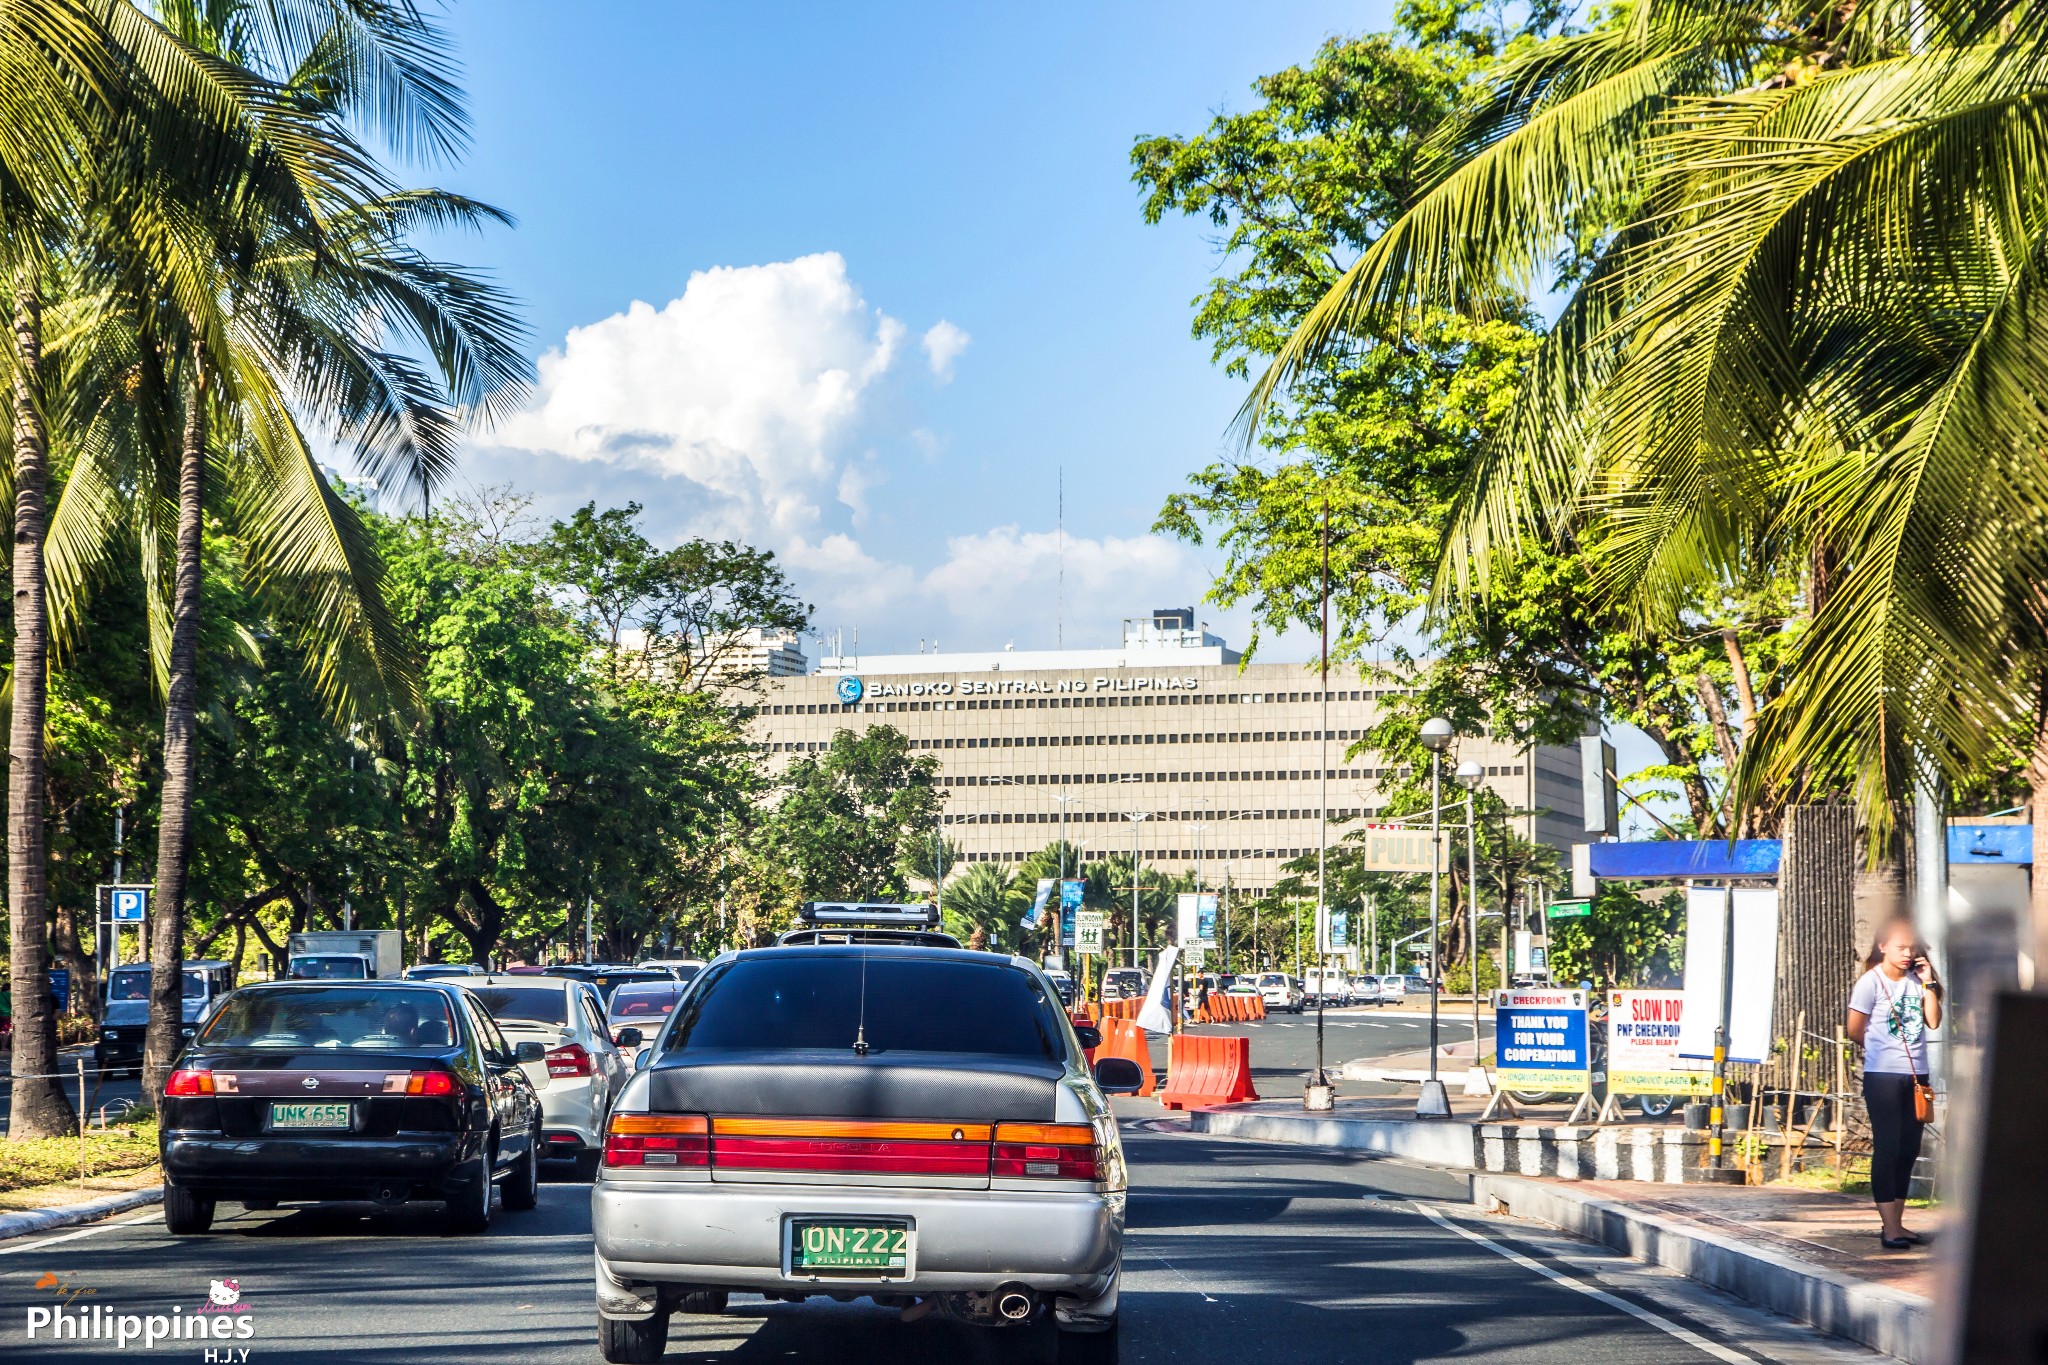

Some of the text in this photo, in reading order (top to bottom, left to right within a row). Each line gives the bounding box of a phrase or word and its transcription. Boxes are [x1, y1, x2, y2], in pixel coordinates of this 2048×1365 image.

[867, 682, 952, 696] BANGKO
[959, 680, 1052, 694] SENTRAL
[1057, 679, 1087, 692] NG
[1094, 677, 1198, 691] PILIPINAS
[1371, 837, 1443, 866] PULIS
[118, 893, 138, 918] P
[1075, 944, 1101, 952] CROSSING
[1186, 956, 1203, 964] OPEN
[1513, 996, 1567, 1005] CHECKPOINT
[1632, 998, 1683, 1021] SLOW DO
[1510, 1015, 1569, 1029] THANK YOU
[1617, 1023, 1633, 1036] PNP
[1514, 1032, 1565, 1046] FOR YOUR
[1631, 1038, 1654, 1046] PLEASE
[1655, 1038, 1673, 1046] BEAR
[1504, 1048, 1577, 1062] COOPERATION
[1664, 1076, 1692, 1086] GARDE
[817, 1256, 881, 1265] PILIPINAS
